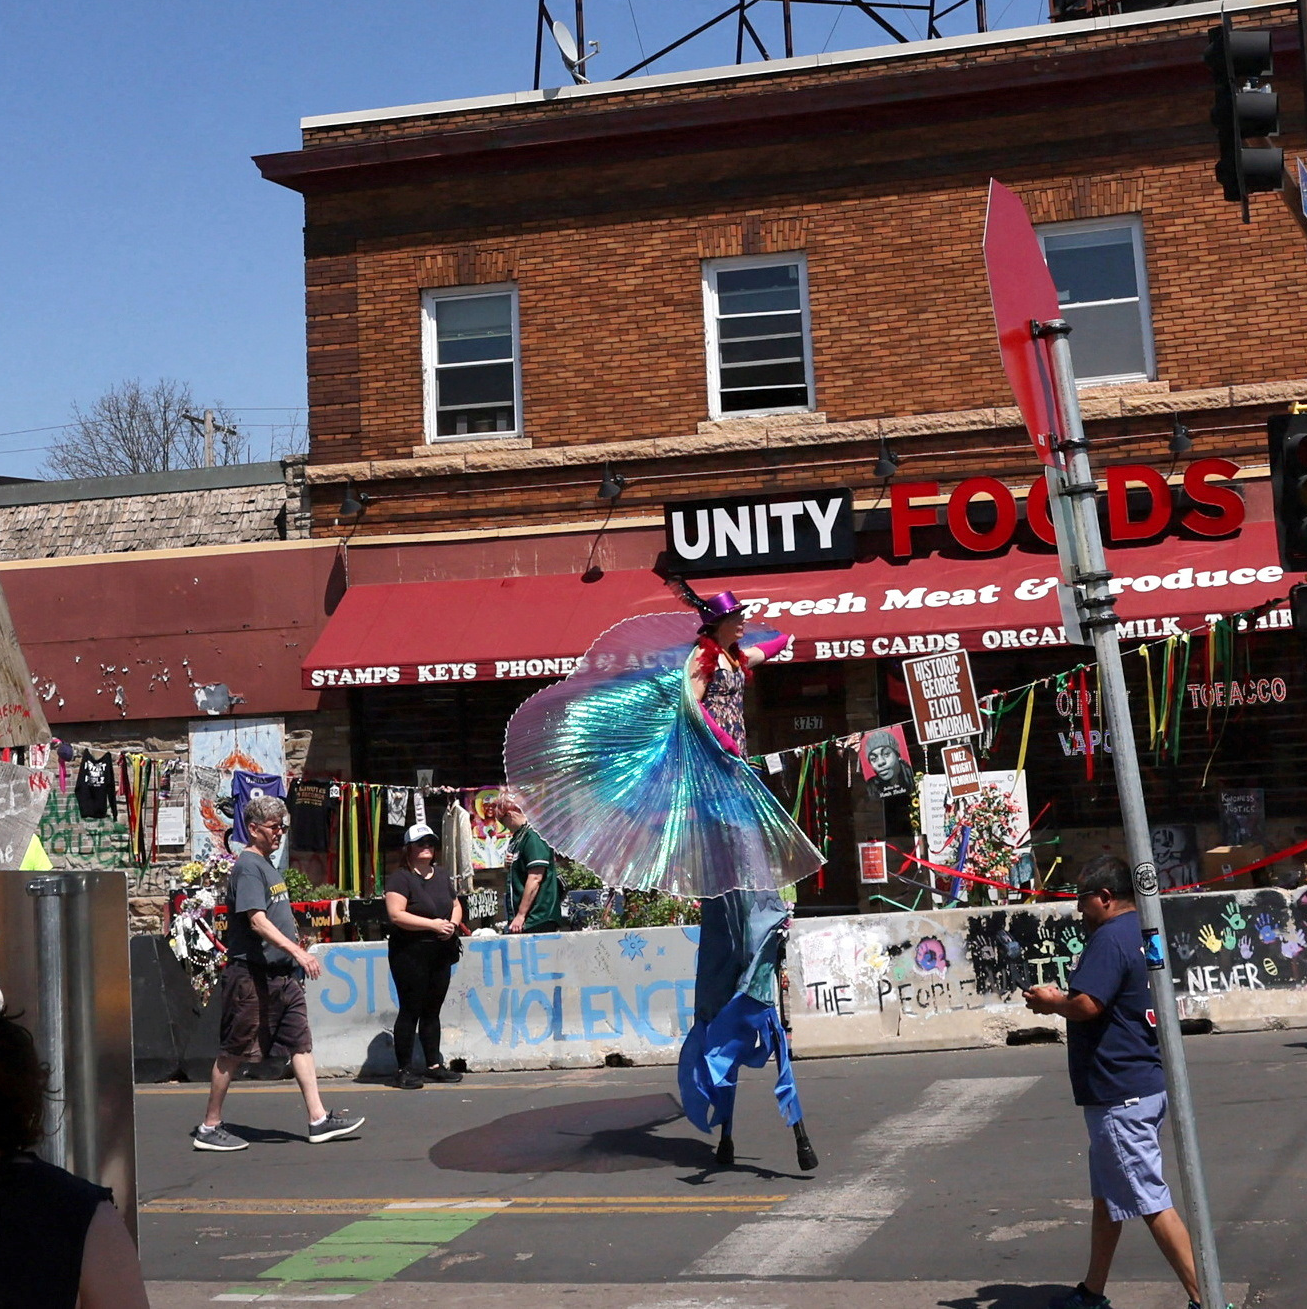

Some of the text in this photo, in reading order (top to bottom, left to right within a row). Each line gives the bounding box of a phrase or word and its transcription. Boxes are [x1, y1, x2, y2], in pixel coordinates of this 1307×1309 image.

[672, 498, 843, 561] UNITY
[740, 565, 1284, 620] Fresh Meat & roduce
[311, 665, 400, 687] STAMPS
[417, 662, 477, 683] KEYS
[495, 656, 585, 679] PHONES
[815, 640, 866, 660] BUS
[872, 632, 960, 655] CARDS
[982, 627, 1068, 650] ORGA
[1114, 616, 1182, 639] MILK
[912, 655, 961, 683] HISTORIC
[921, 674, 961, 699] GEORGE
[928, 695, 962, 720] FLOYD
[795, 716, 823, 731] 3757
[924, 713, 977, 741] MEMORIAL
[950, 759, 973, 775] WRIGHT
[950, 770, 978, 788] MEMORIAL
[468, 890, 498, 907] NO JUSTICE
[469, 900, 498, 921] NO PEACE
[311, 916, 331, 927] NOW
[469, 934, 564, 987] THE
[807, 981, 855, 1016] THE
[877, 978, 985, 1020] PEOPLE
[1187, 962, 1266, 995] NEVER
[467, 979, 696, 1049] VIOLENCE
